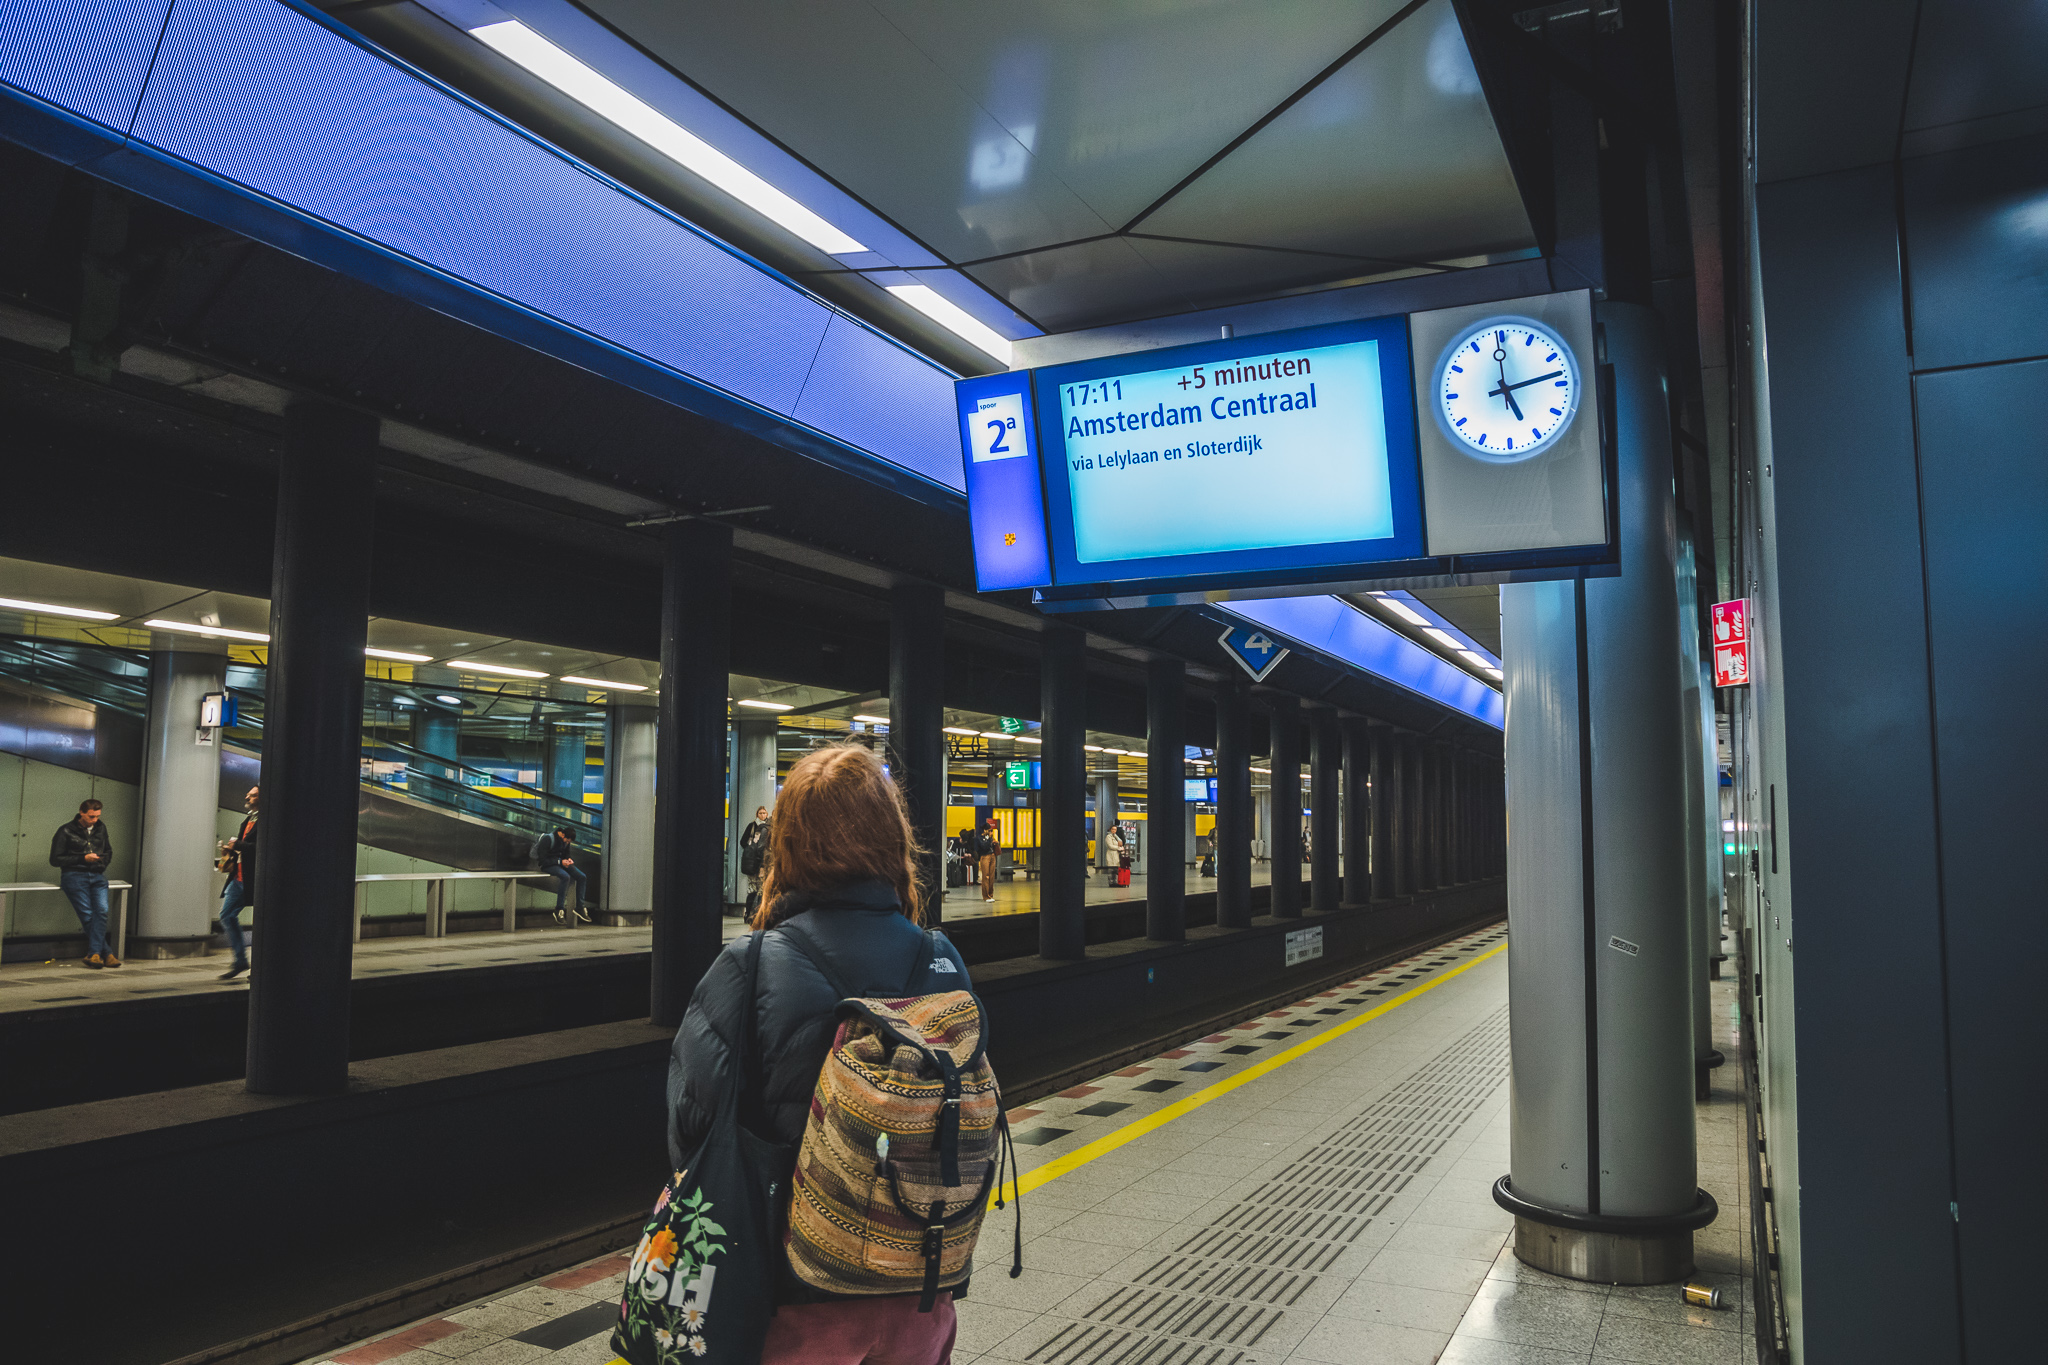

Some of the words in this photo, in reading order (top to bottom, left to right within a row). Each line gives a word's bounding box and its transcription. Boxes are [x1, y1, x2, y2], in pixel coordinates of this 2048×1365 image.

[1066, 380, 1122, 407] 17:11
[1177, 367, 1206, 391] +5
[1214, 357, 1311, 387] minuten
[979, 402, 997, 411] spoor
[1067, 403, 1202, 439] Amsterdam
[1210, 383, 1317, 420] Centraal
[1072, 456, 1094, 472] via
[1098, 449, 1159, 470] Lelylaan
[1163, 447, 1182, 461] en
[1186, 434, 1263, 458] Sloterdijk
[1245, 631, 1272, 655] 4
